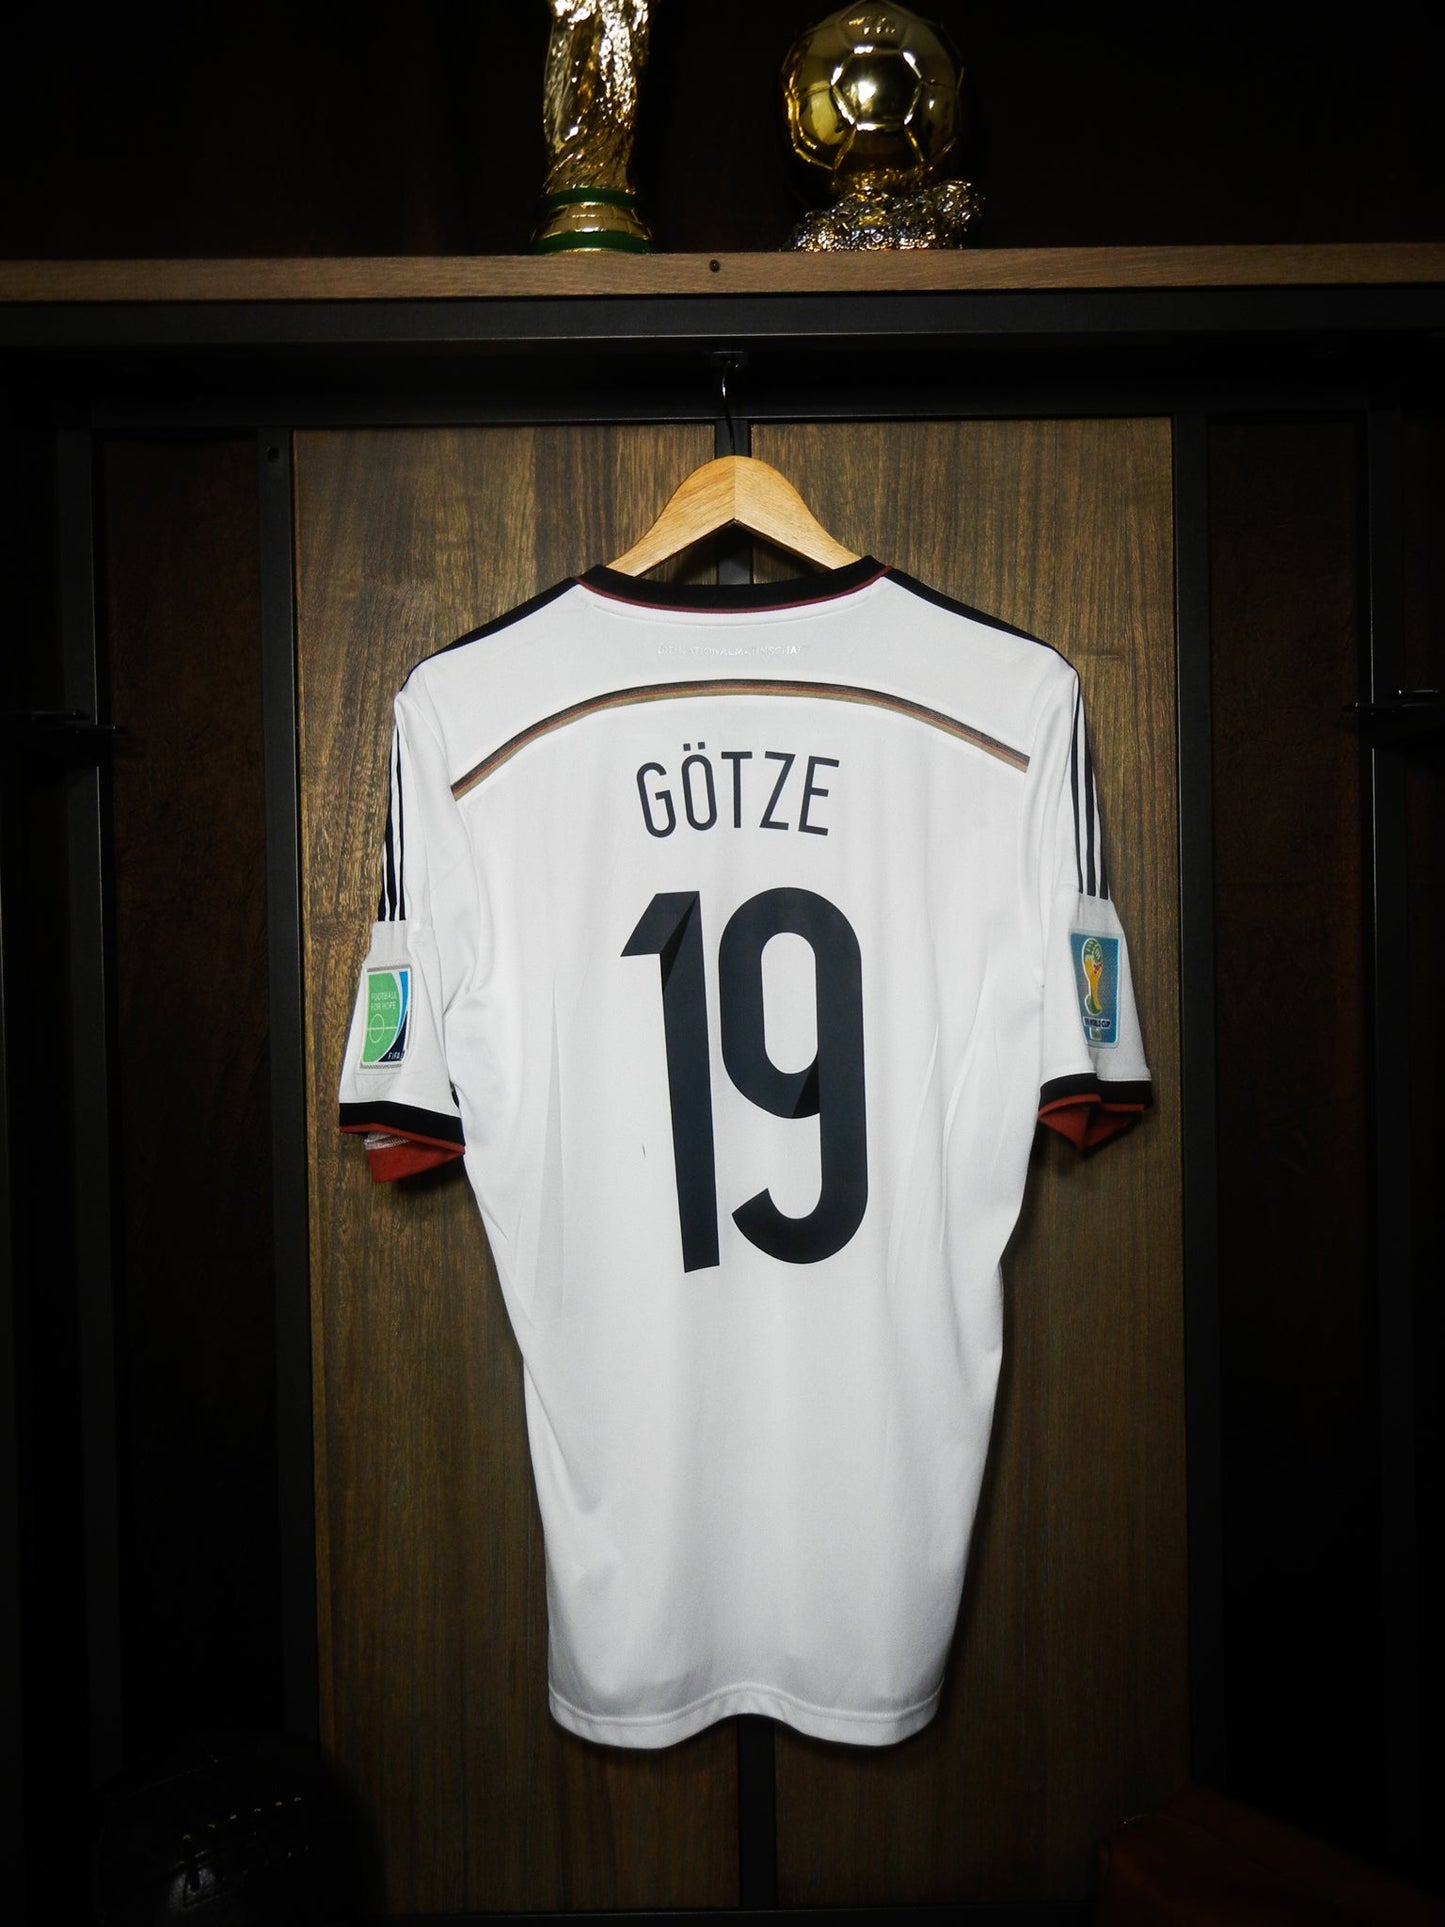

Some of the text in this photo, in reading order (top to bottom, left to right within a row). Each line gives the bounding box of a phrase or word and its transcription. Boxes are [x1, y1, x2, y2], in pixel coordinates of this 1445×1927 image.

[636, 741, 840, 838] GÖTZE
[387, 1051, 401, 1060] FIFA
[620, 887, 868, 1273] 19
